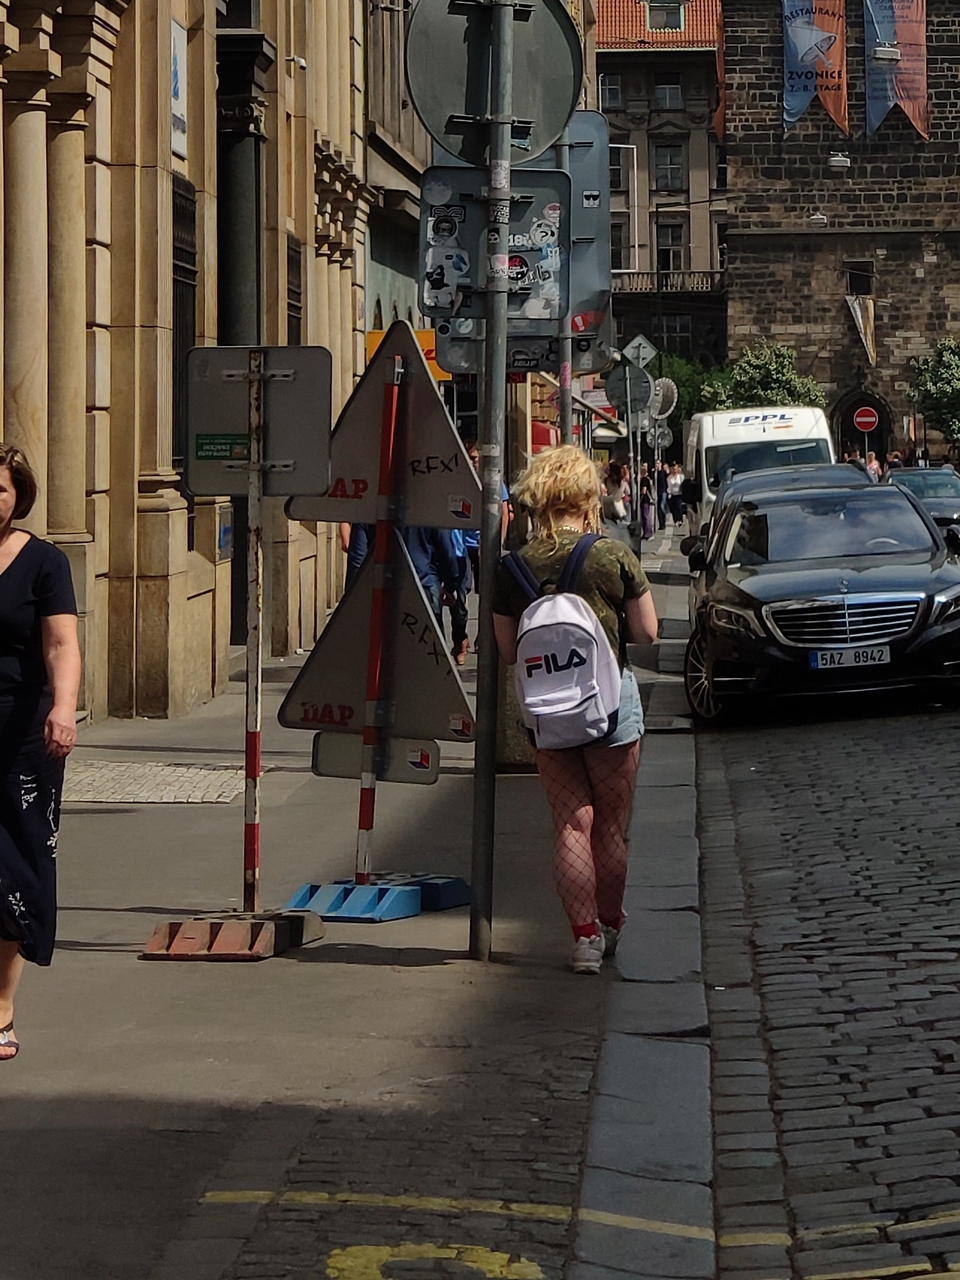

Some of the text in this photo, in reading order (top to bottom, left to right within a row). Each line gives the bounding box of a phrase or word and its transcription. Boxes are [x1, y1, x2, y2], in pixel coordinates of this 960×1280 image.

[784, 6, 844, 23] RESTAURANT
[787, 70, 843, 80] ZVONICE
[743, 414, 793, 423] PPL
[327, 477, 369, 499] AP
[524, 648, 587, 678] FILA
[820, 649, 885, 666] 5AZ 8942
